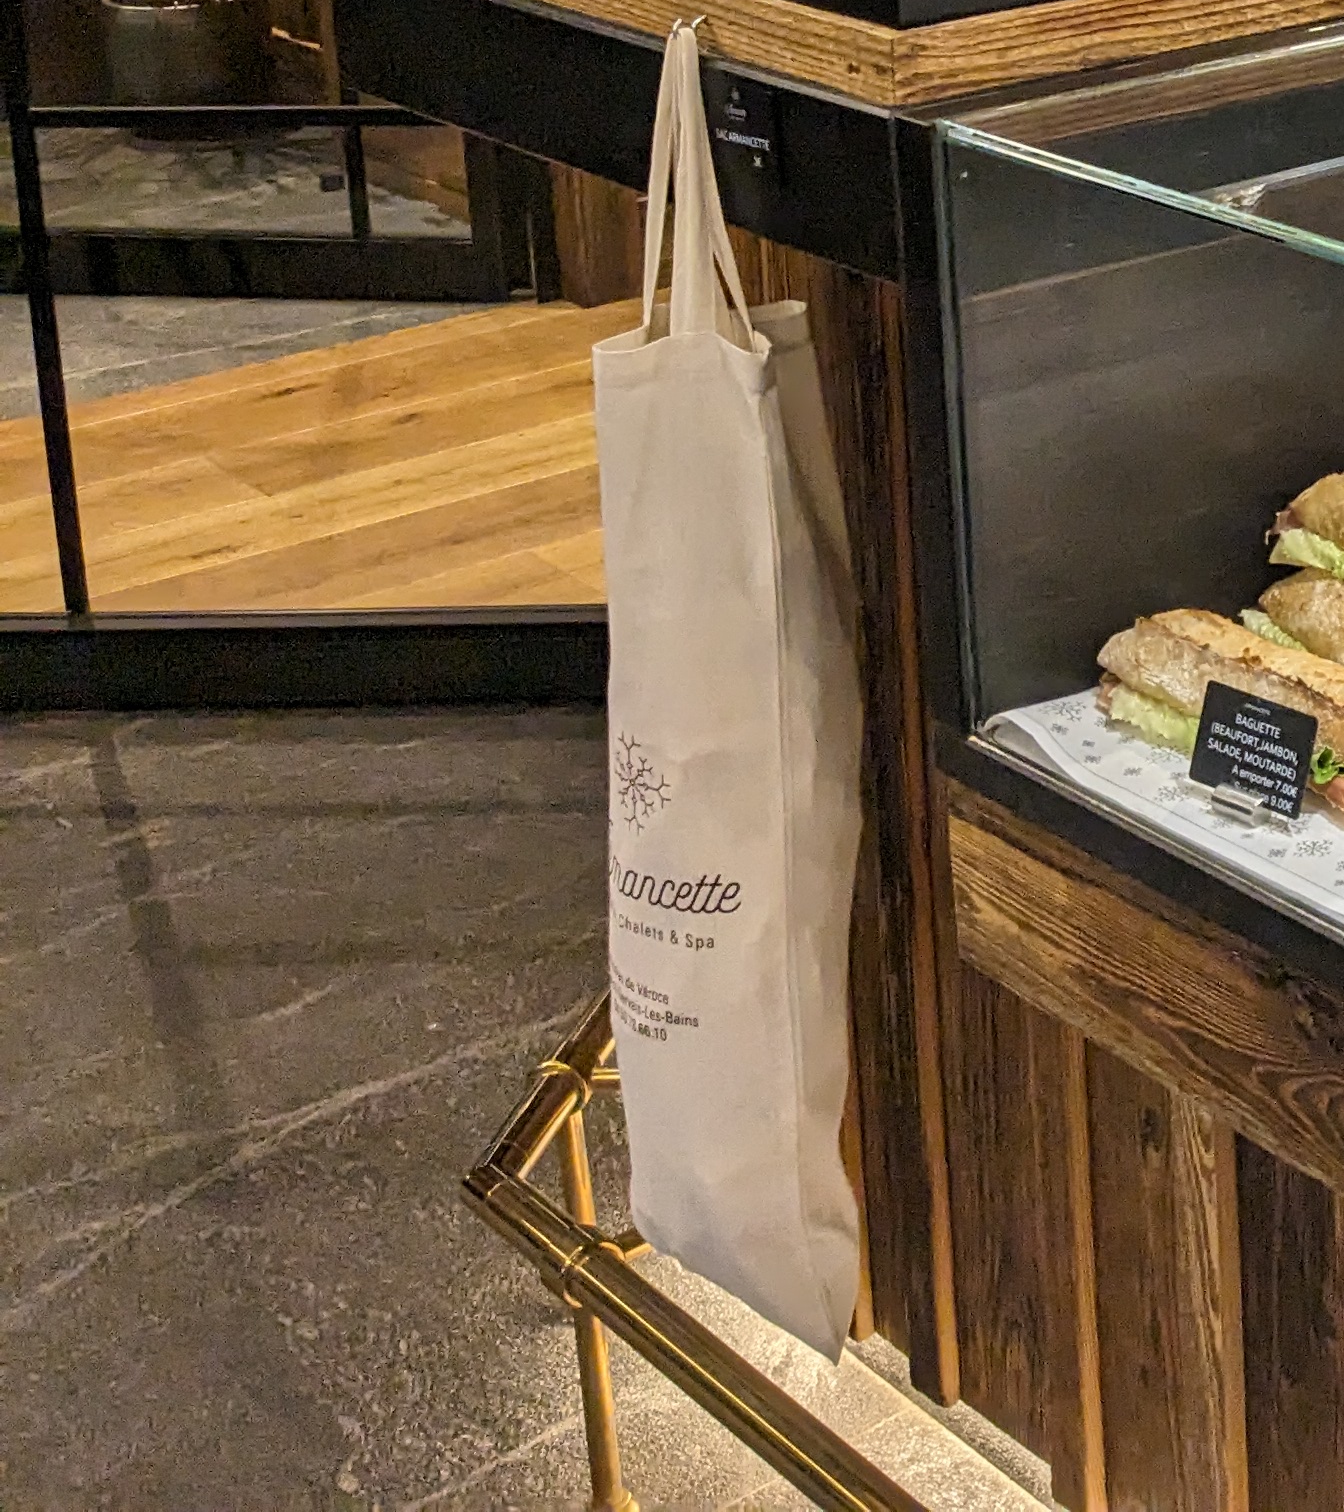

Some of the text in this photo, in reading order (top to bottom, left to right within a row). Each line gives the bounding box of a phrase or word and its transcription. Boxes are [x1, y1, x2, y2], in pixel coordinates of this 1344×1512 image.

[1235, 713, 1281, 739] BAGUETTE
[1207, 738, 1296, 782] SALADE, MOUTARDE)
[1232, 765, 1239, 775] A
[1239, 768, 1275, 788] emporter
[685, 933, 715, 951] Spa
